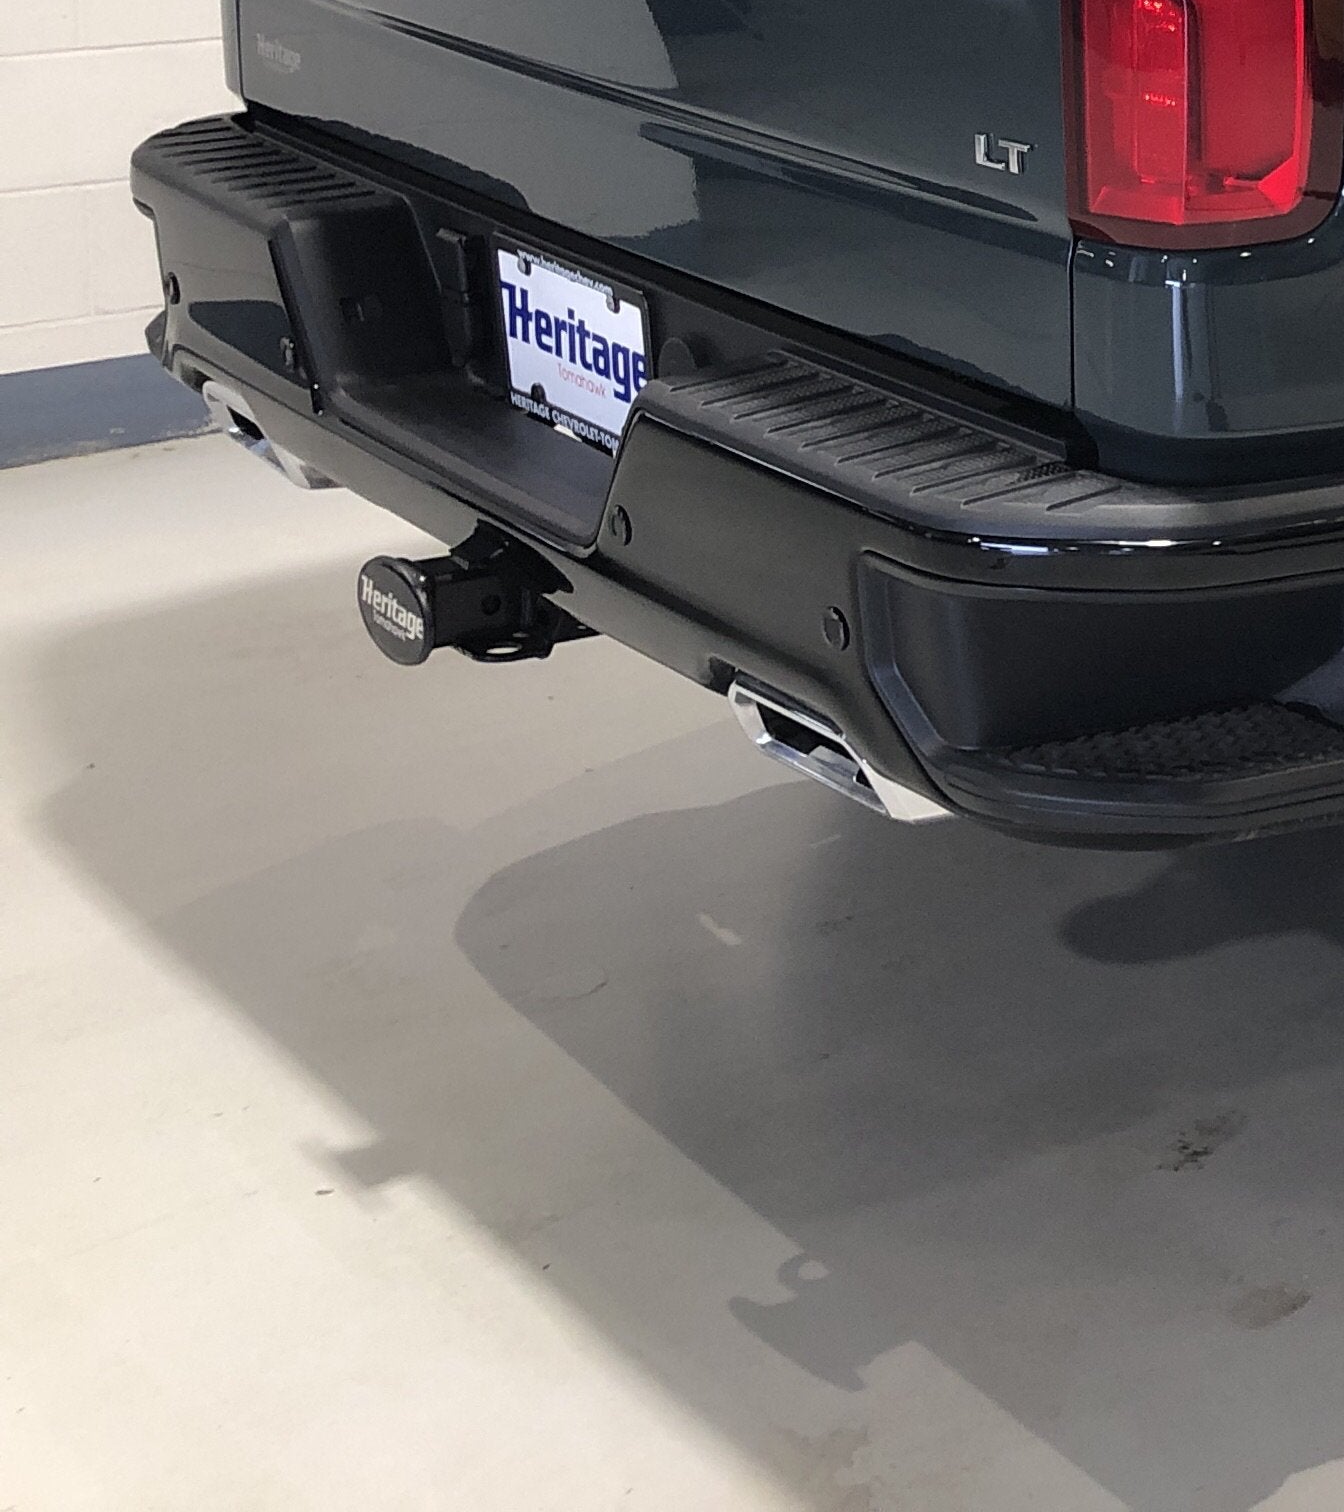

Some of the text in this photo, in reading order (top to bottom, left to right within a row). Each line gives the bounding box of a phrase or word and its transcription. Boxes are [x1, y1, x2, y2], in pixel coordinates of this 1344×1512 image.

[974, 132, 1031, 175] LT
[500, 279, 647, 404] Heritage
[510, 390, 551, 421] HERITAGE
[361, 573, 424, 641] Heritage
